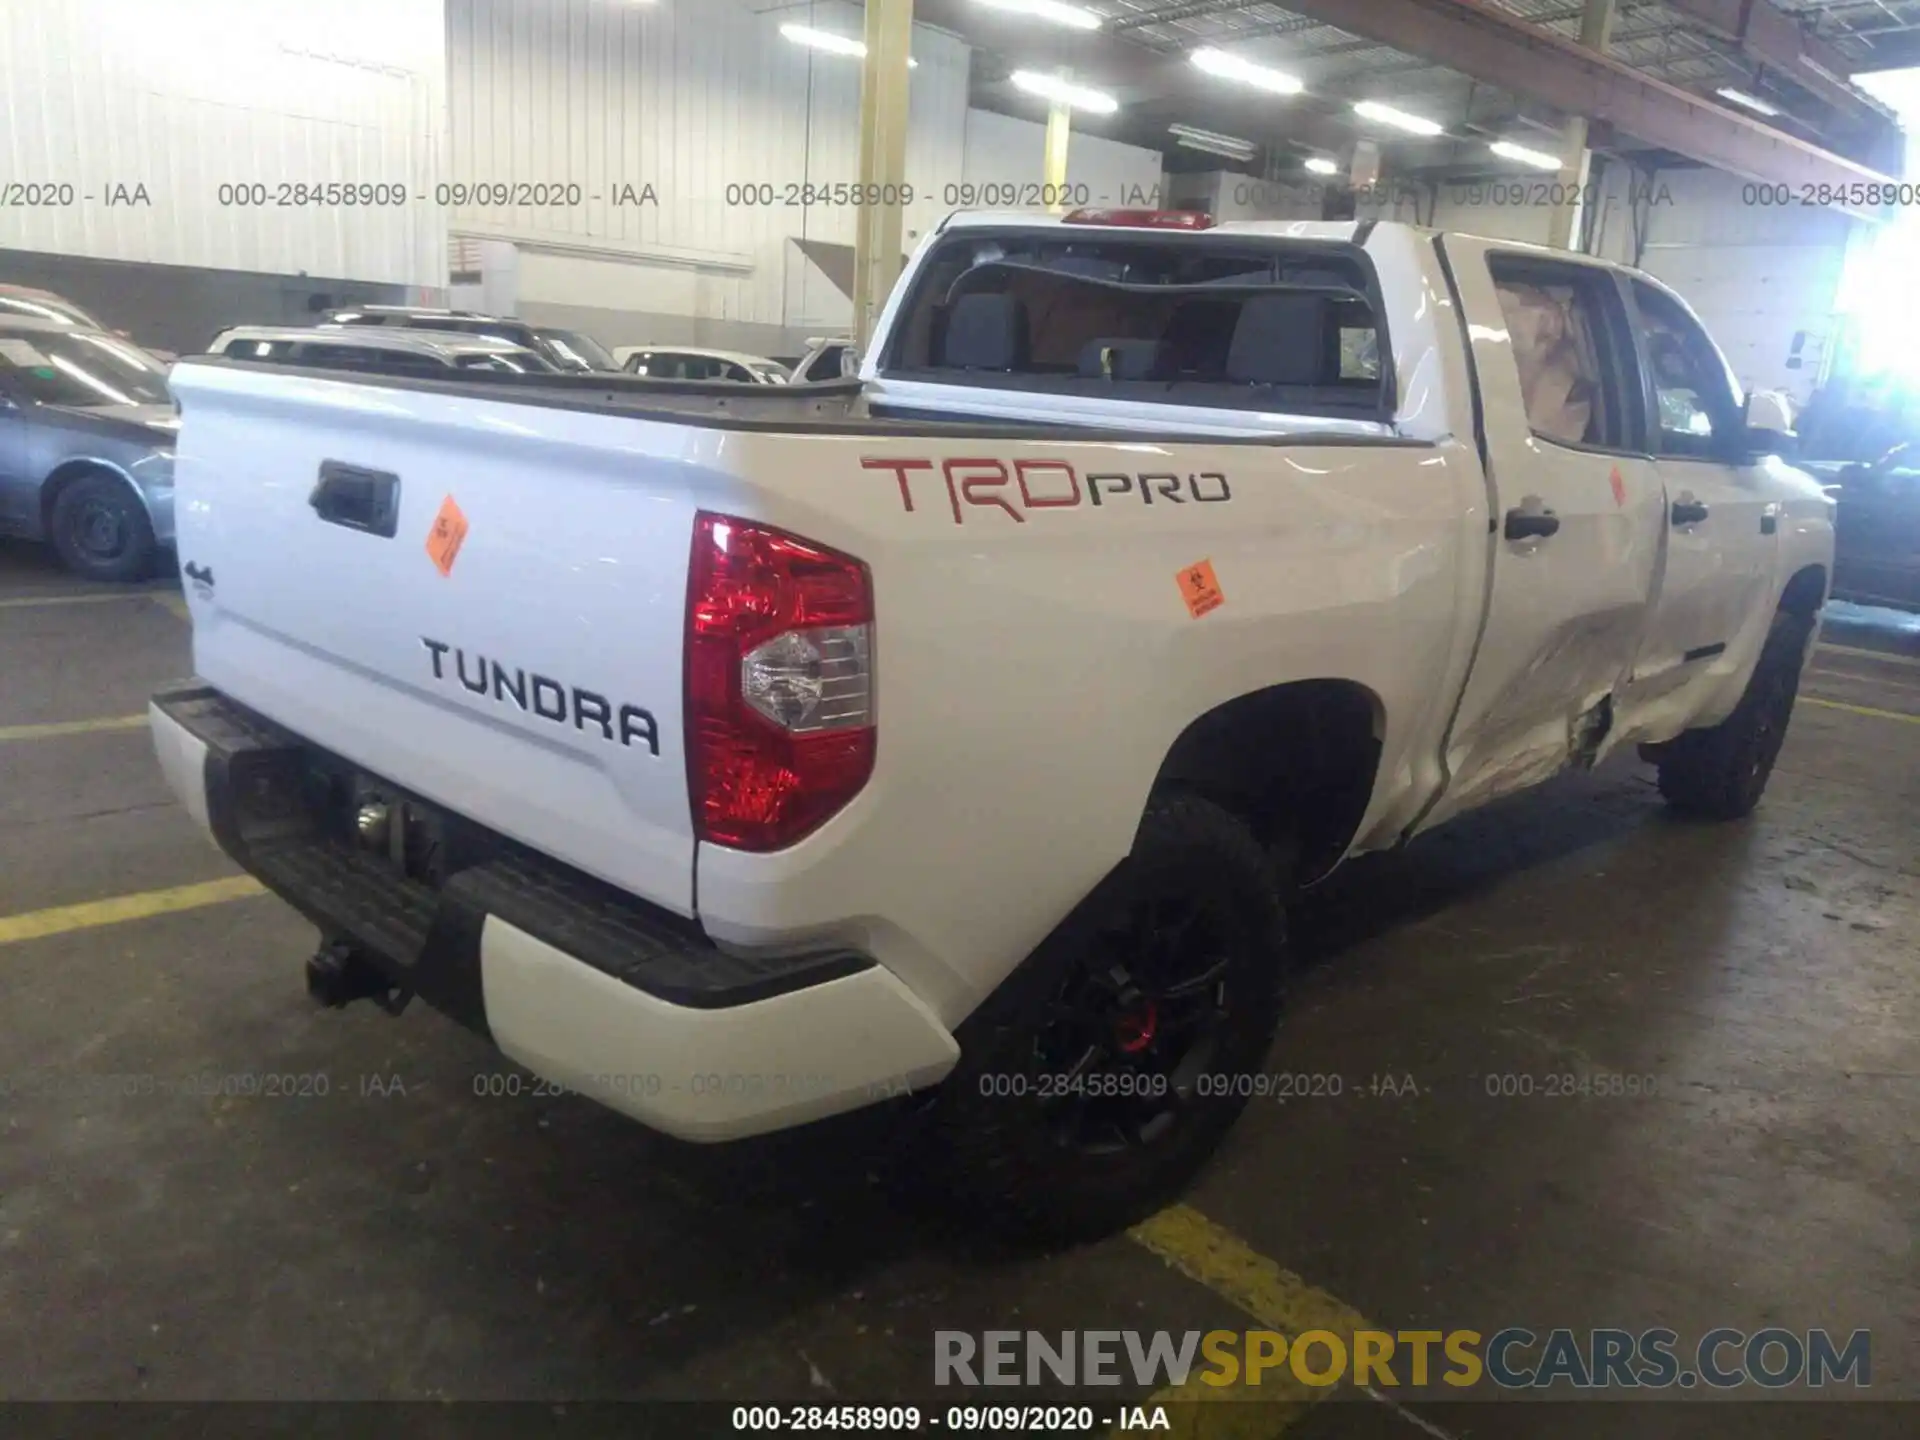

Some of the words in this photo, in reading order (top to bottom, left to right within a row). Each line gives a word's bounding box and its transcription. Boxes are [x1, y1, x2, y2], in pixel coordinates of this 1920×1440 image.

[859, 457, 1081, 525] TRD
[1086, 473, 1231, 506] PRO
[419, 636, 660, 757] TUNDRA
